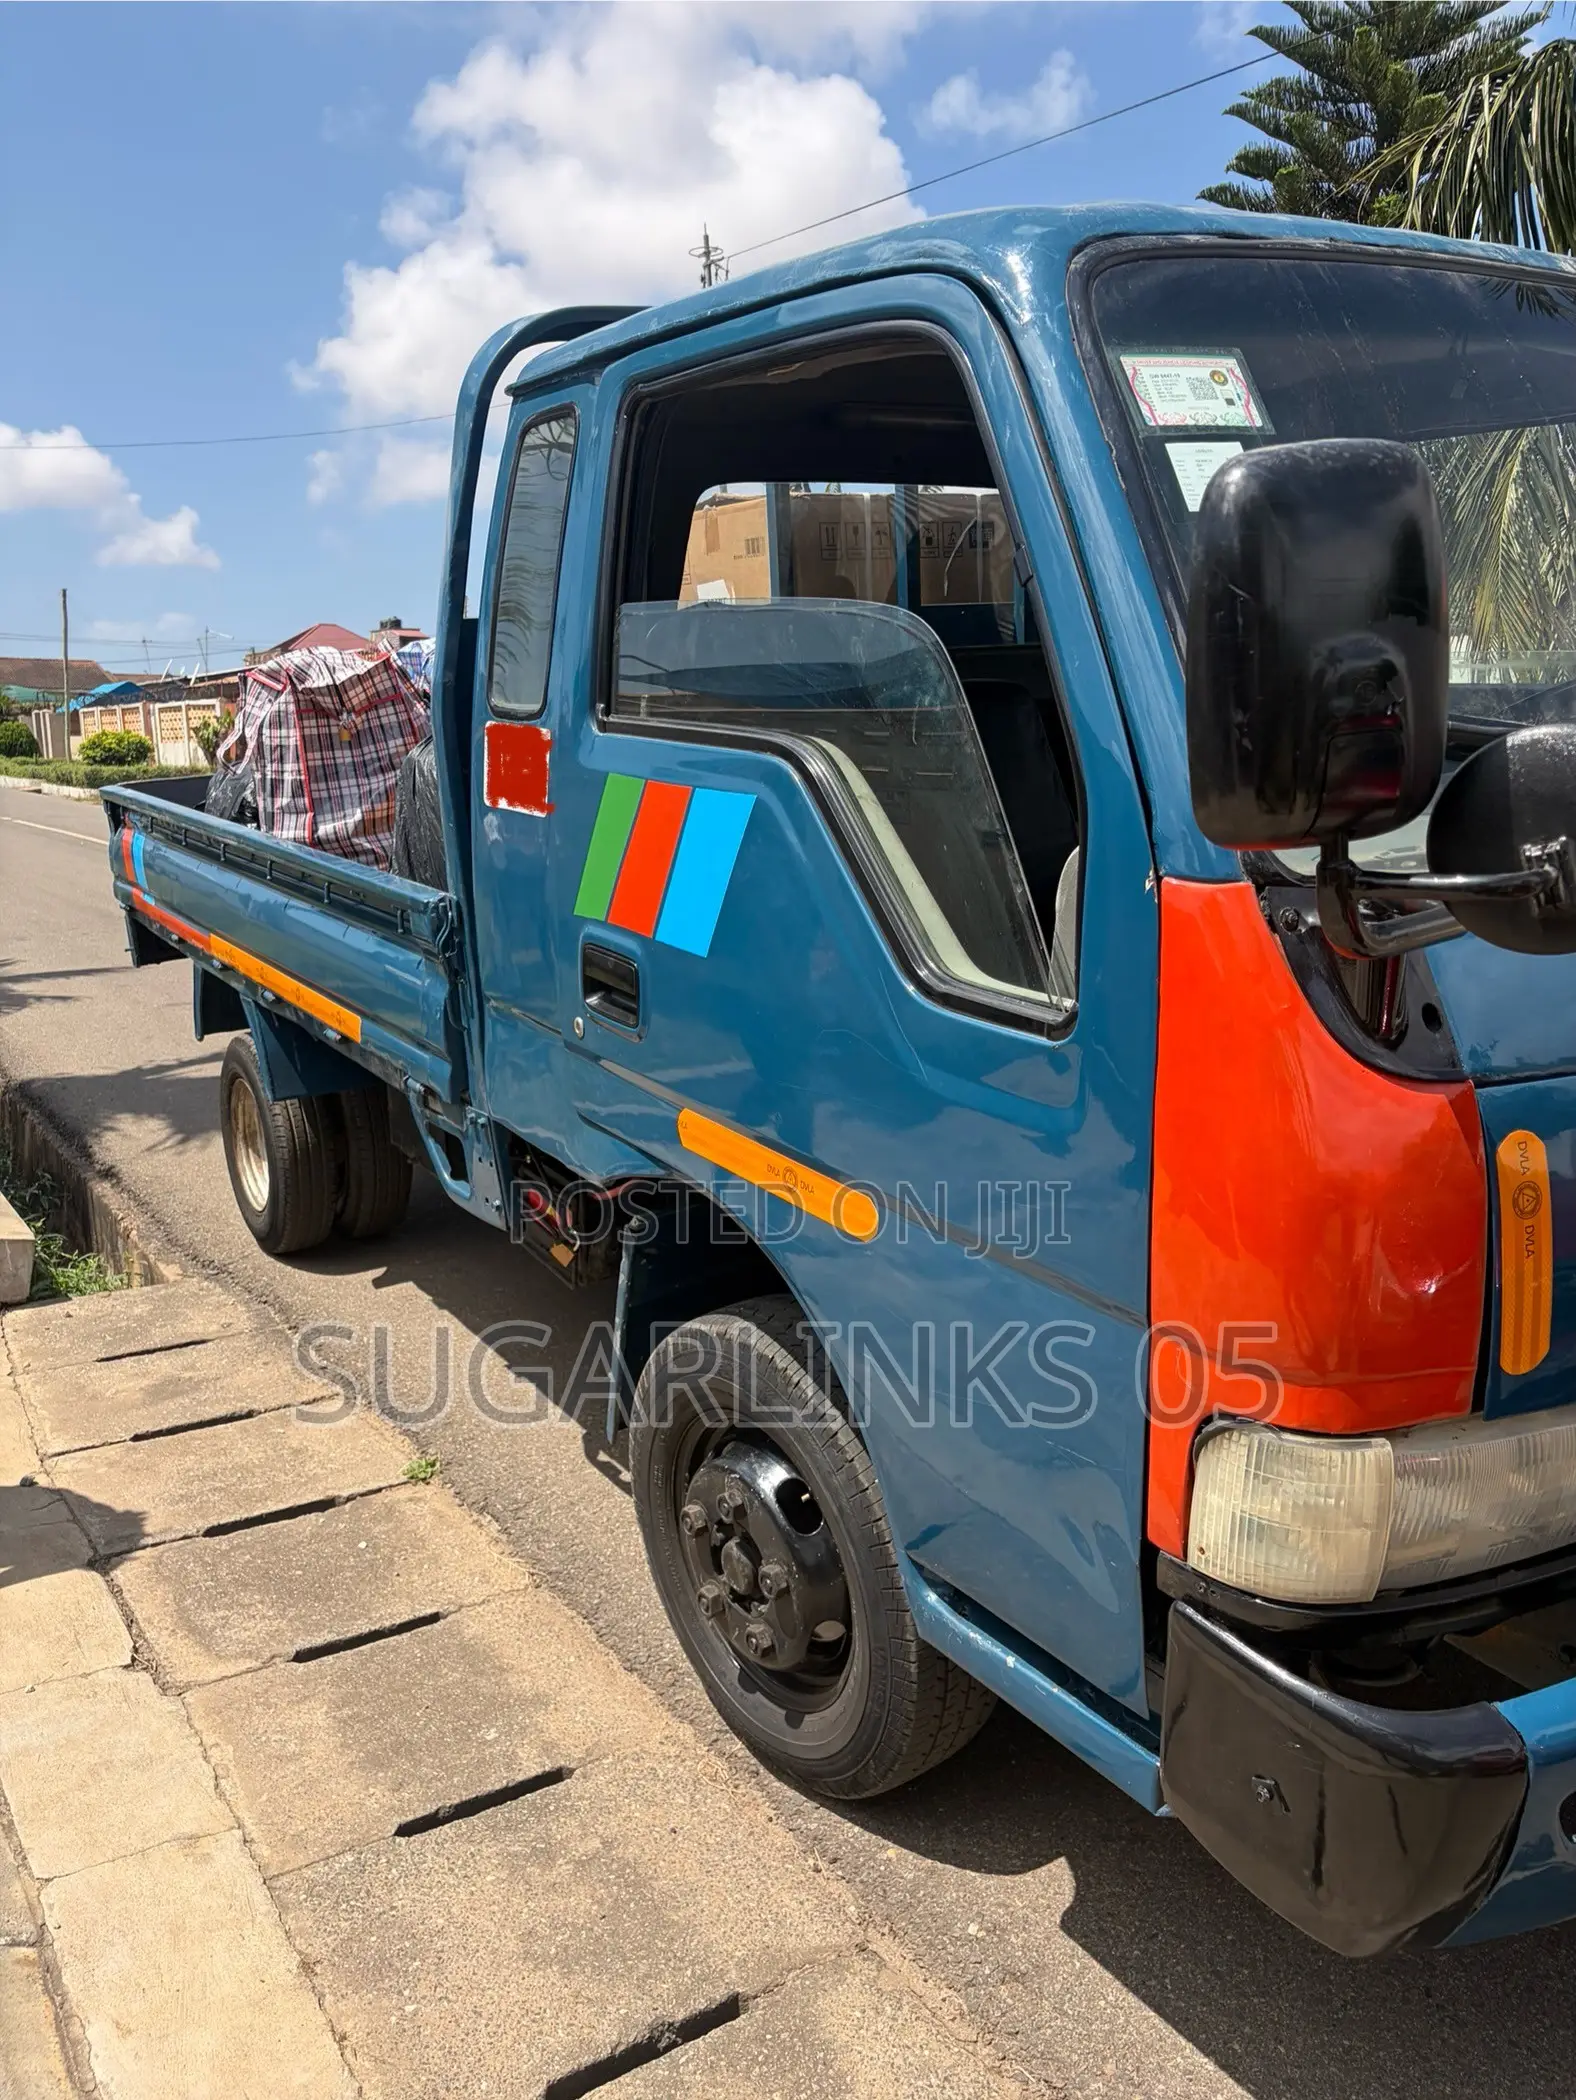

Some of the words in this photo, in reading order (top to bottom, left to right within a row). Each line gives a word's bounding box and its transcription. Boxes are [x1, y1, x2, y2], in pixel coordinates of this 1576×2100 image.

[766, 1163, 780, 1177] DVLA
[1517, 1140, 1530, 1176] DVLA
[800, 1180, 815, 1194] DVLA
[1525, 1225, 1535, 1259] DVLA
